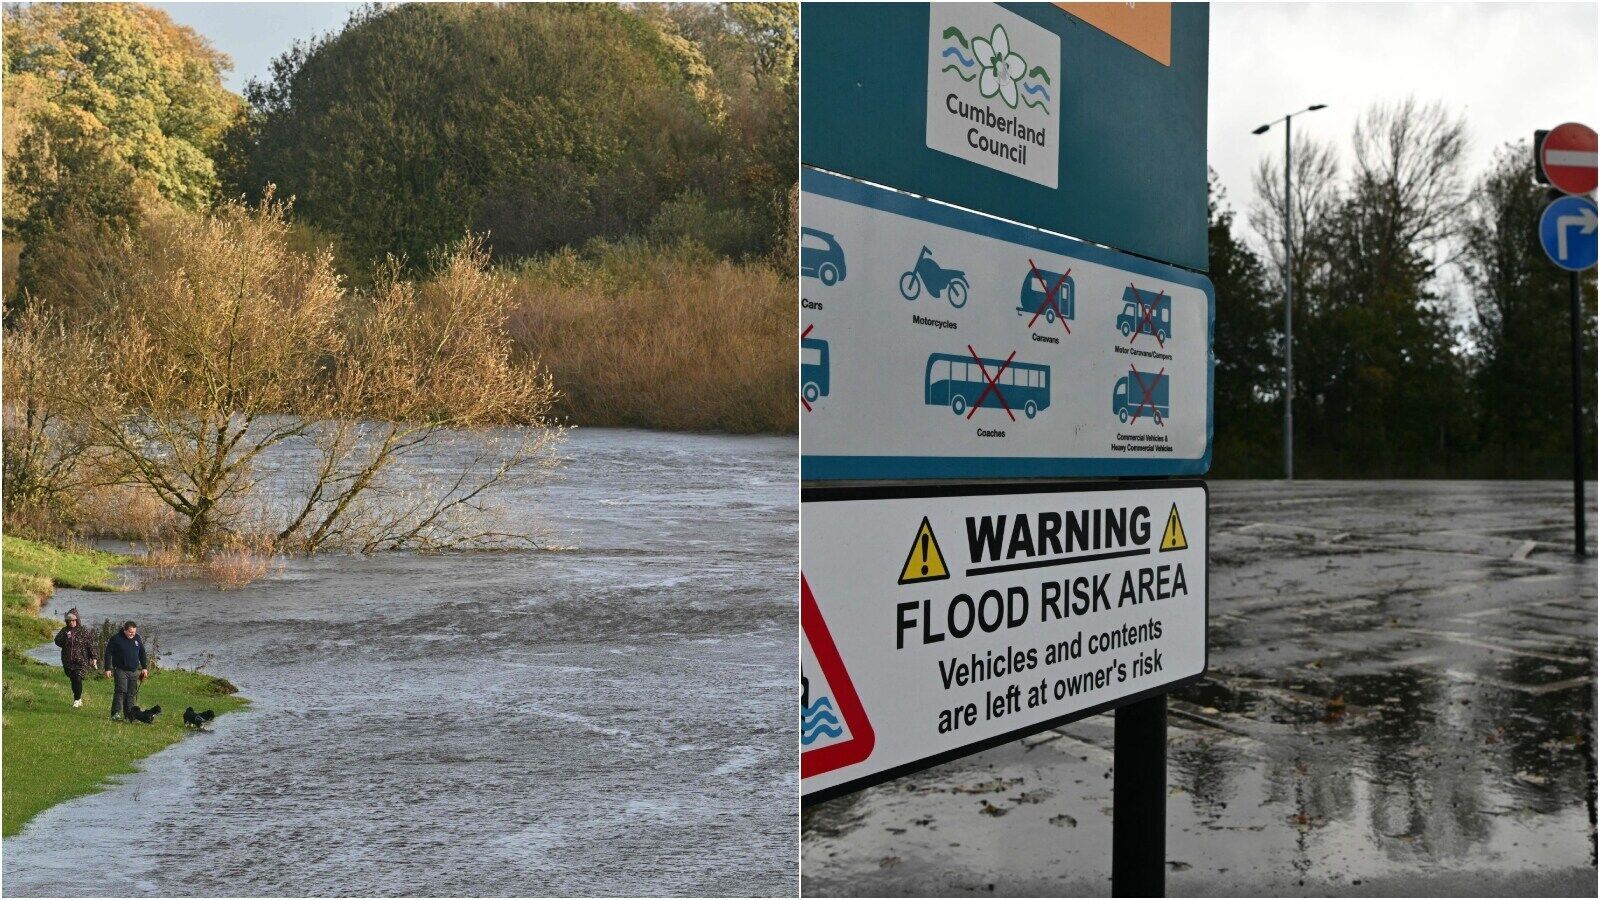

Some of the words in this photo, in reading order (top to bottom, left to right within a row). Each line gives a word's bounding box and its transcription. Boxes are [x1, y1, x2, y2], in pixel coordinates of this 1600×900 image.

[946, 93, 1045, 147] Cumberland
[967, 128, 1026, 165] Council
[801, 298, 823, 311] Cars
[912, 315, 958, 330] Motorcycles
[1032, 332, 1060, 345] Caravans
[1114, 345, 1129, 354] Motor
[1130, 348, 1172, 360] Caravans/Campers
[977, 428, 1006, 438] Coaches
[1117, 433, 1145, 441] Commercial
[1111, 444, 1126, 452] Heavy
[1127, 444, 1155, 452] Commercial
[965, 505, 1151, 564] WARNING
[896, 585, 1029, 650] FLOOD
[1041, 573, 1111, 623] RISK
[1117, 562, 1188, 608] AREA
[938, 648, 1038, 690] Vehicles
[1045, 631, 1082, 665] and
[1088, 617, 1163, 655] contents
[938, 701, 977, 734] are
[986, 690, 1021, 721] left
[1027, 680, 1048, 709] at
[1054, 658, 1126, 701] owner's
[1132, 648, 1163, 680] risk
